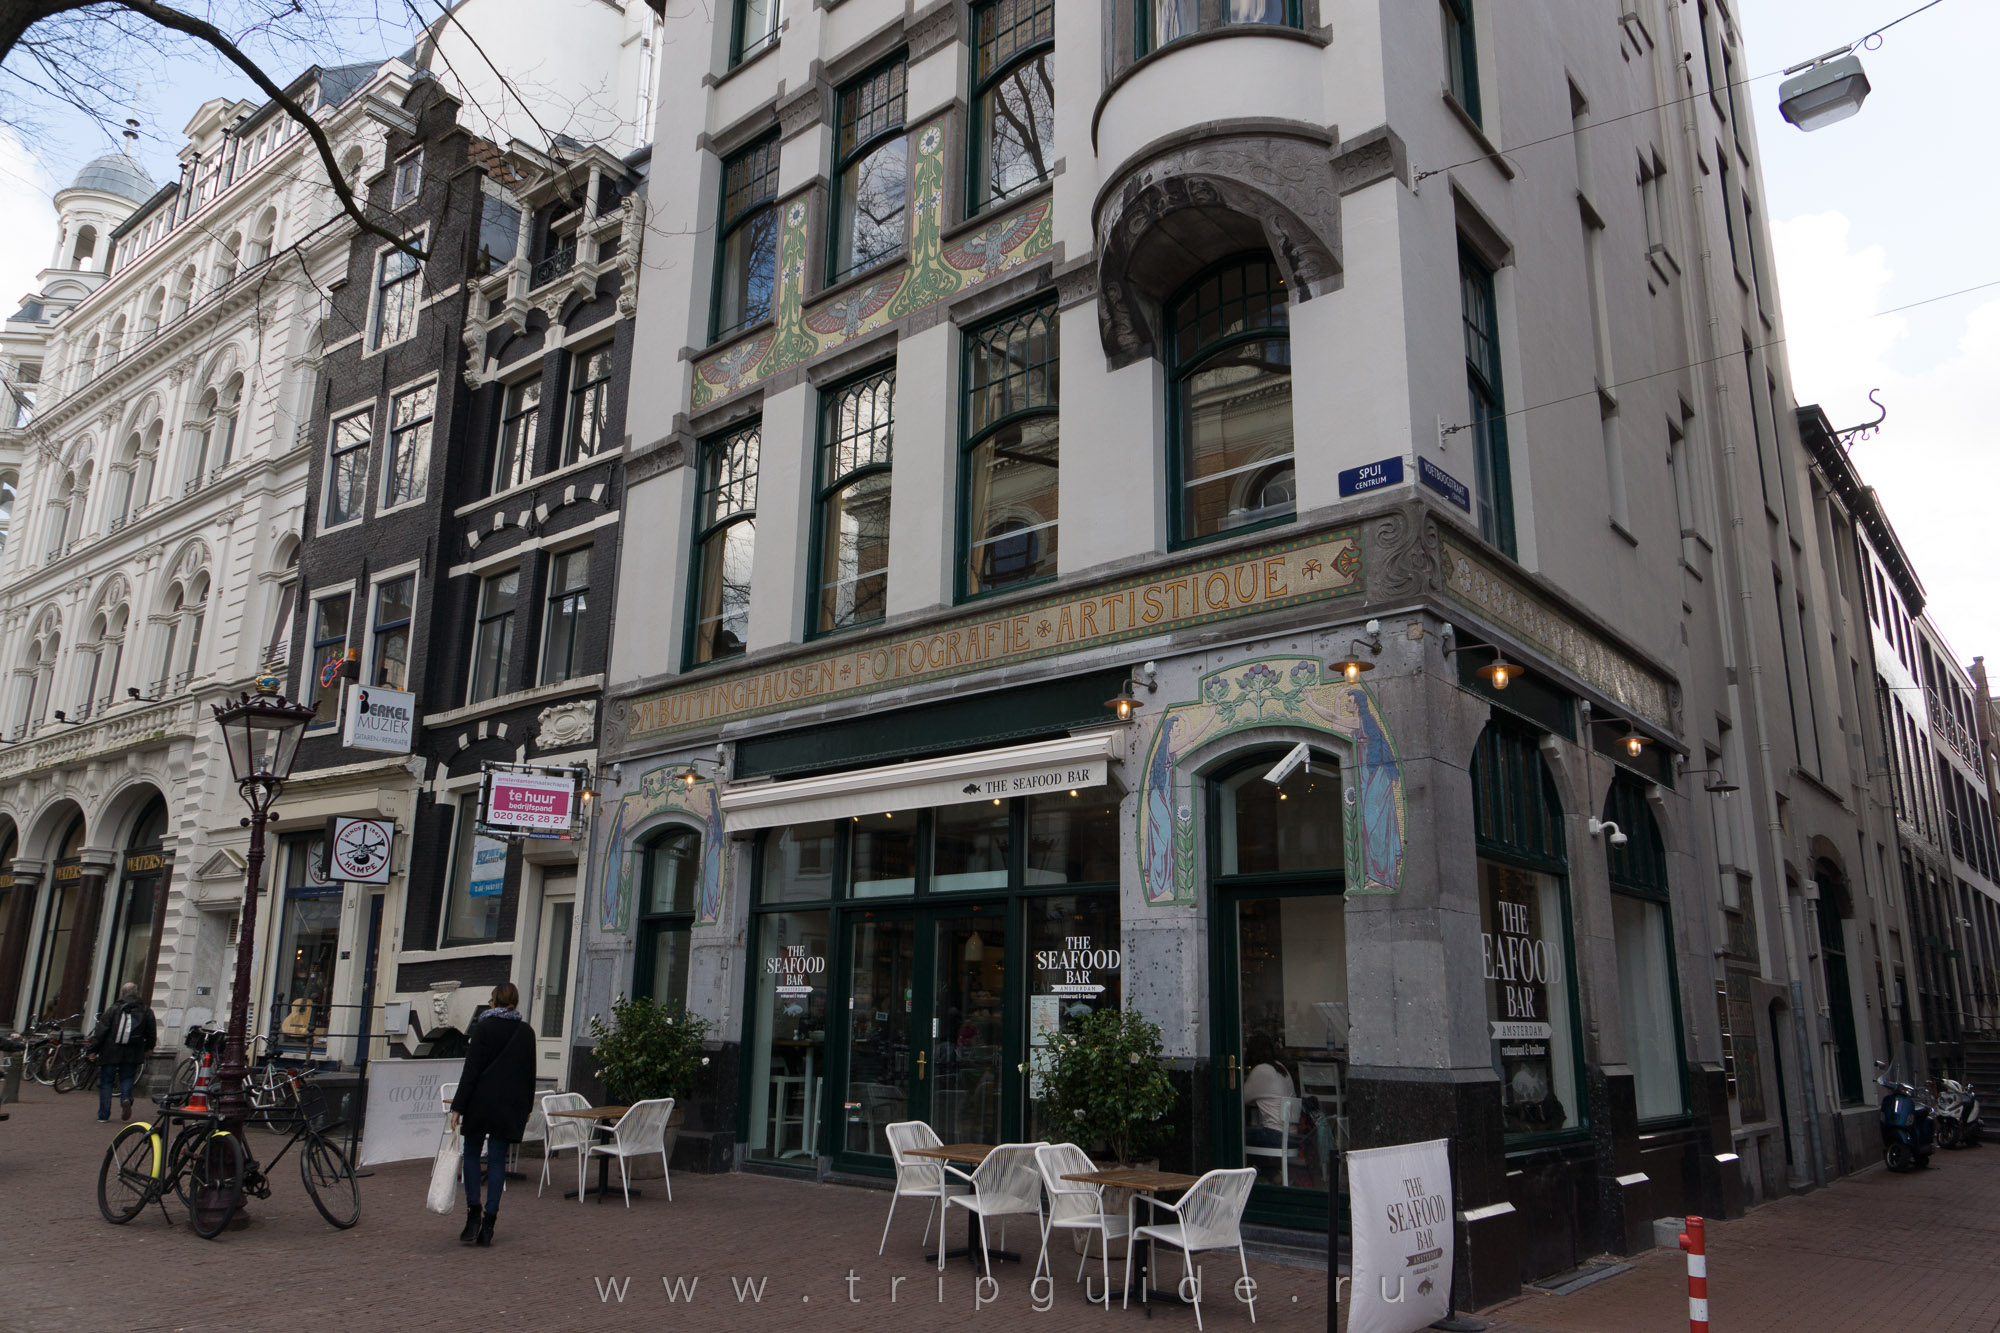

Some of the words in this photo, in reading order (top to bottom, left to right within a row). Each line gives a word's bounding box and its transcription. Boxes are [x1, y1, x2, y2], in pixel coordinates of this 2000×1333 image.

[1359, 464, 1381, 480] SPUI
[1355, 475, 1387, 490] CENTRUM
[855, 616, 1030, 685] FOTOGRAFIE
[1056, 557, 1288, 643] ARTISTIQUE
[359, 690, 410, 721] BERKEL
[357, 716, 409, 734] MUZIEK
[985, 779, 1008, 794] THE
[1013, 773, 1062, 791] SEAFOOD
[1067, 768, 1090, 784] BAR
[509, 789, 522, 802] te
[525, 790, 556, 804] huur
[508, 802, 552, 813] bedrijfspand
[493, 811, 513, 820] 020
[516, 813, 535, 822] 626
[537, 815, 550, 823] 28
[553, 816, 565, 824] 27
[344, 860, 378, 873] HAMPE
[1498, 901, 1529, 935] THE
[787, 945, 805, 957] THE
[1065, 936, 1091, 950] THE
[767, 957, 825, 974] SEAFOOD
[1037, 949, 1121, 970] SEAFOOD
[1481, 933, 1562, 984] EAFOOD
[786, 974, 804, 986] BAR
[1066, 970, 1091, 984] BAR
[1505, 985, 1536, 1018] BAR
[1502, 1025, 1543, 1037] AMSTERDAM
[1403, 1177, 1425, 1198] THE
[1387, 1194, 1446, 1234] SEAFOOD
[1416, 1228, 1435, 1250] BAR
